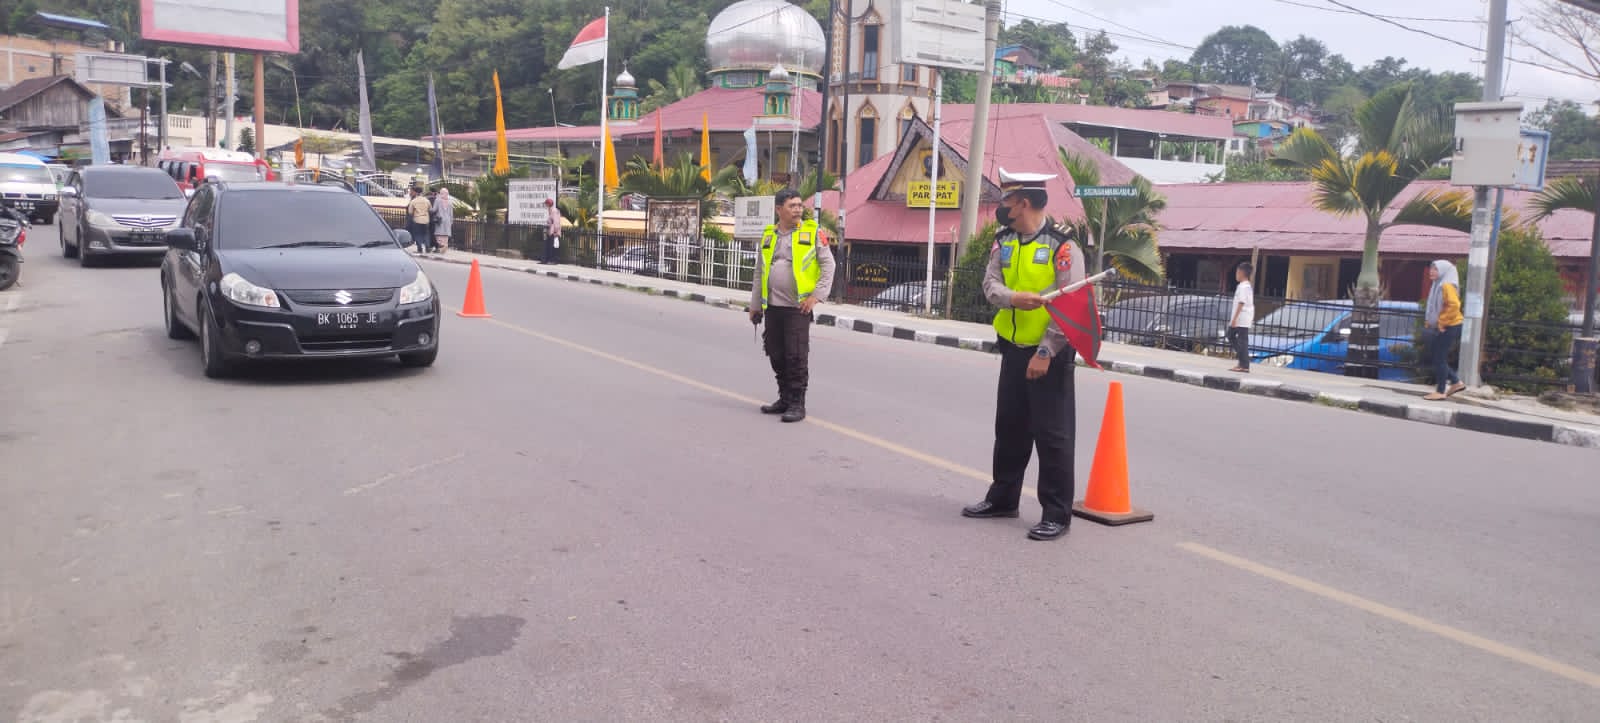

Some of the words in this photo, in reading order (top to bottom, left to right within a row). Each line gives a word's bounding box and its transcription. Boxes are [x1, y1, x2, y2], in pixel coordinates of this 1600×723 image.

[912, 191, 953, 200] PARPAT
[318, 312, 330, 325] BK
[336, 312, 359, 324] 1065
[366, 312, 377, 323] JE
